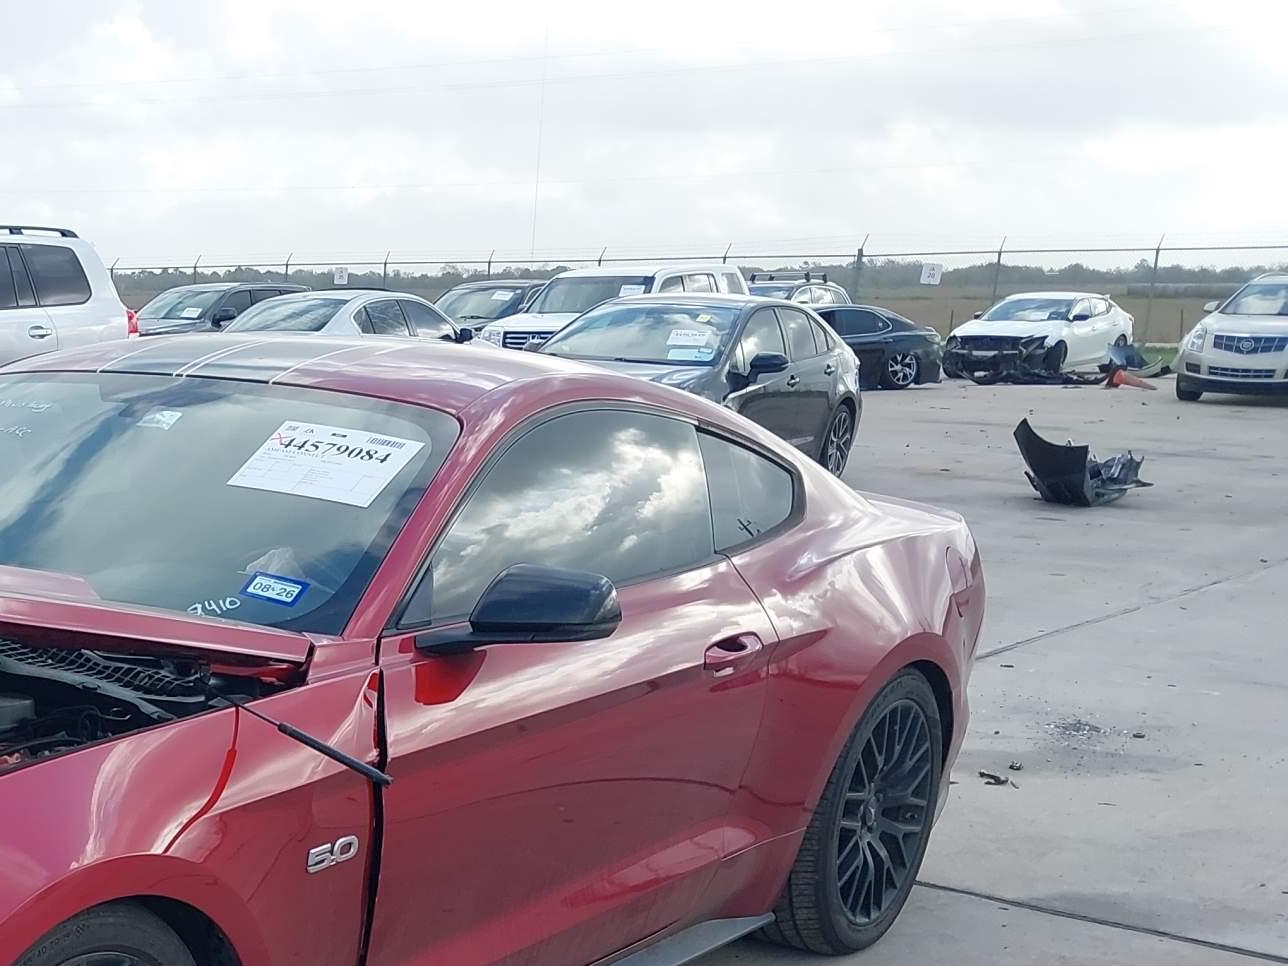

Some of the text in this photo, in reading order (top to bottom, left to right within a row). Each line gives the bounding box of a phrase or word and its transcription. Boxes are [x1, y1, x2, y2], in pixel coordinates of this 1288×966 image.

[279, 435, 393, 464] 44579084
[253, 582, 296, 598] 08 26
[307, 835, 359, 873] 5.0
